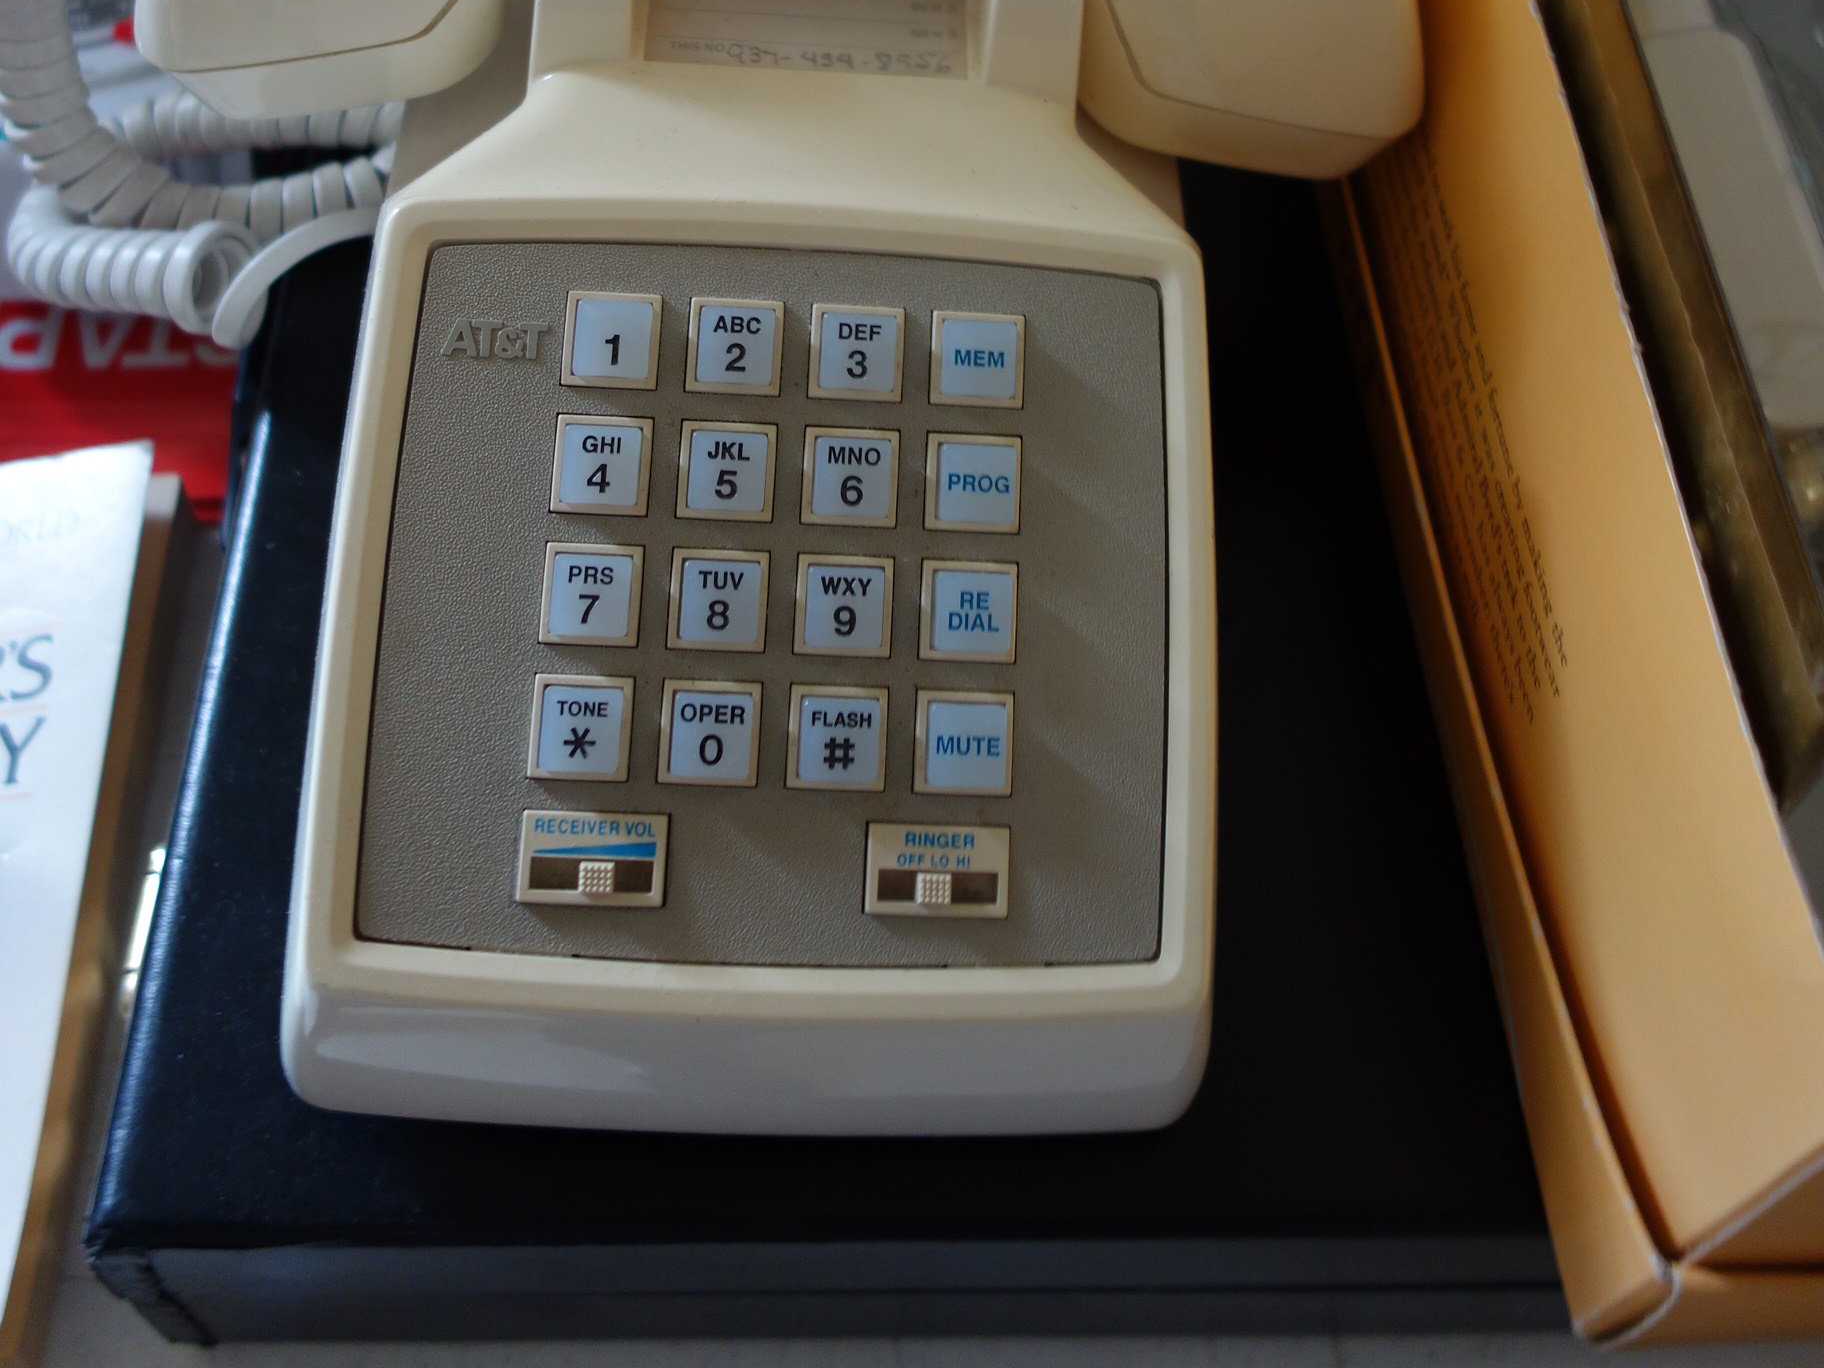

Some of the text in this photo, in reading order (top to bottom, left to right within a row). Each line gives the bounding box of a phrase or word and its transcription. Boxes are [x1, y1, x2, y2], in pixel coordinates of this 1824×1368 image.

[713, 315, 761, 335] ABC
[838, 322, 882, 342] DEF
[440, 318, 549, 360] AT&T
[604, 334, 621, 367] 1
[724, 343, 747, 373] 2
[953, 349, 1006, 369] MEM
[846, 350, 868, 380] 3
[581, 435, 622, 455] GHI
[707, 441, 751, 461] JKL
[827, 446, 881, 466] MNO
[586, 463, 610, 494] 4
[714, 469, 738, 500] 5
[947, 473, 1011, 494] PROG
[840, 475, 864, 507] 6
[567, 565, 614, 586] PRS
[698, 571, 744, 591] TUV
[821, 576, 872, 597] WXY
[578, 594, 600, 624] 7
[959, 591, 990, 611] RE
[706, 600, 730, 630] 8
[833, 606, 857, 637] 9
[947, 612, 1000, 633] DIAL
[556, 700, 608, 719] TONE
[680, 703, 745, 725] OPER
[811, 710, 873, 728] FLASH
[698, 734, 724, 766] 0
[936, 735, 1001, 758] MUTE
[533, 817, 656, 838] RECEIVER VOL
[904, 831, 975, 850] RINGER
[896, 853, 971, 869] OFF LO HI
